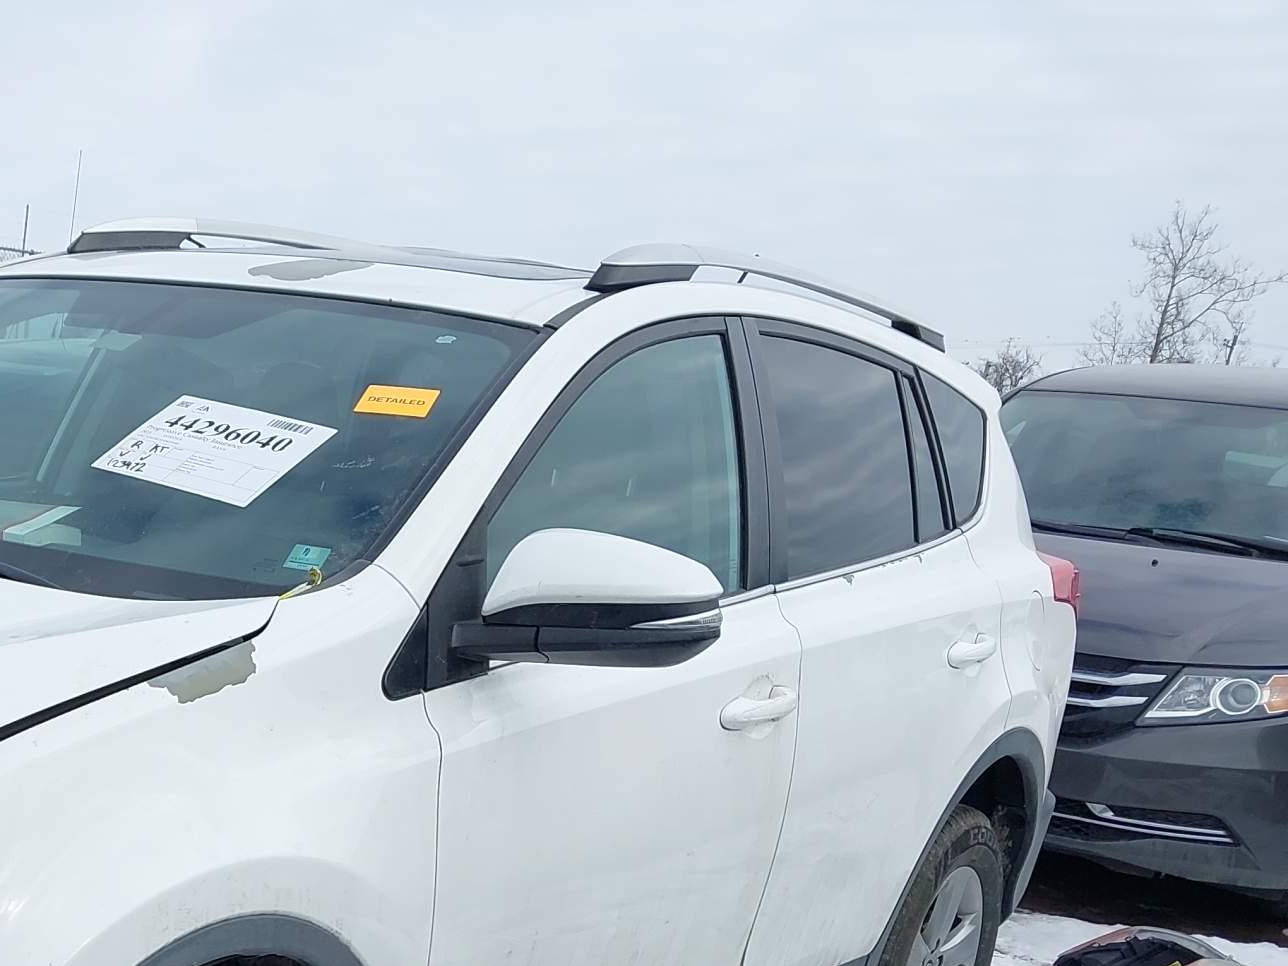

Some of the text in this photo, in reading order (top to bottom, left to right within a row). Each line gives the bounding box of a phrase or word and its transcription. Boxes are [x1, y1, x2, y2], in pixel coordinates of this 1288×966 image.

[367, 395, 426, 406] DETAILED
[165, 415, 294, 453] 44296040
[130, 440, 144, 449] R
